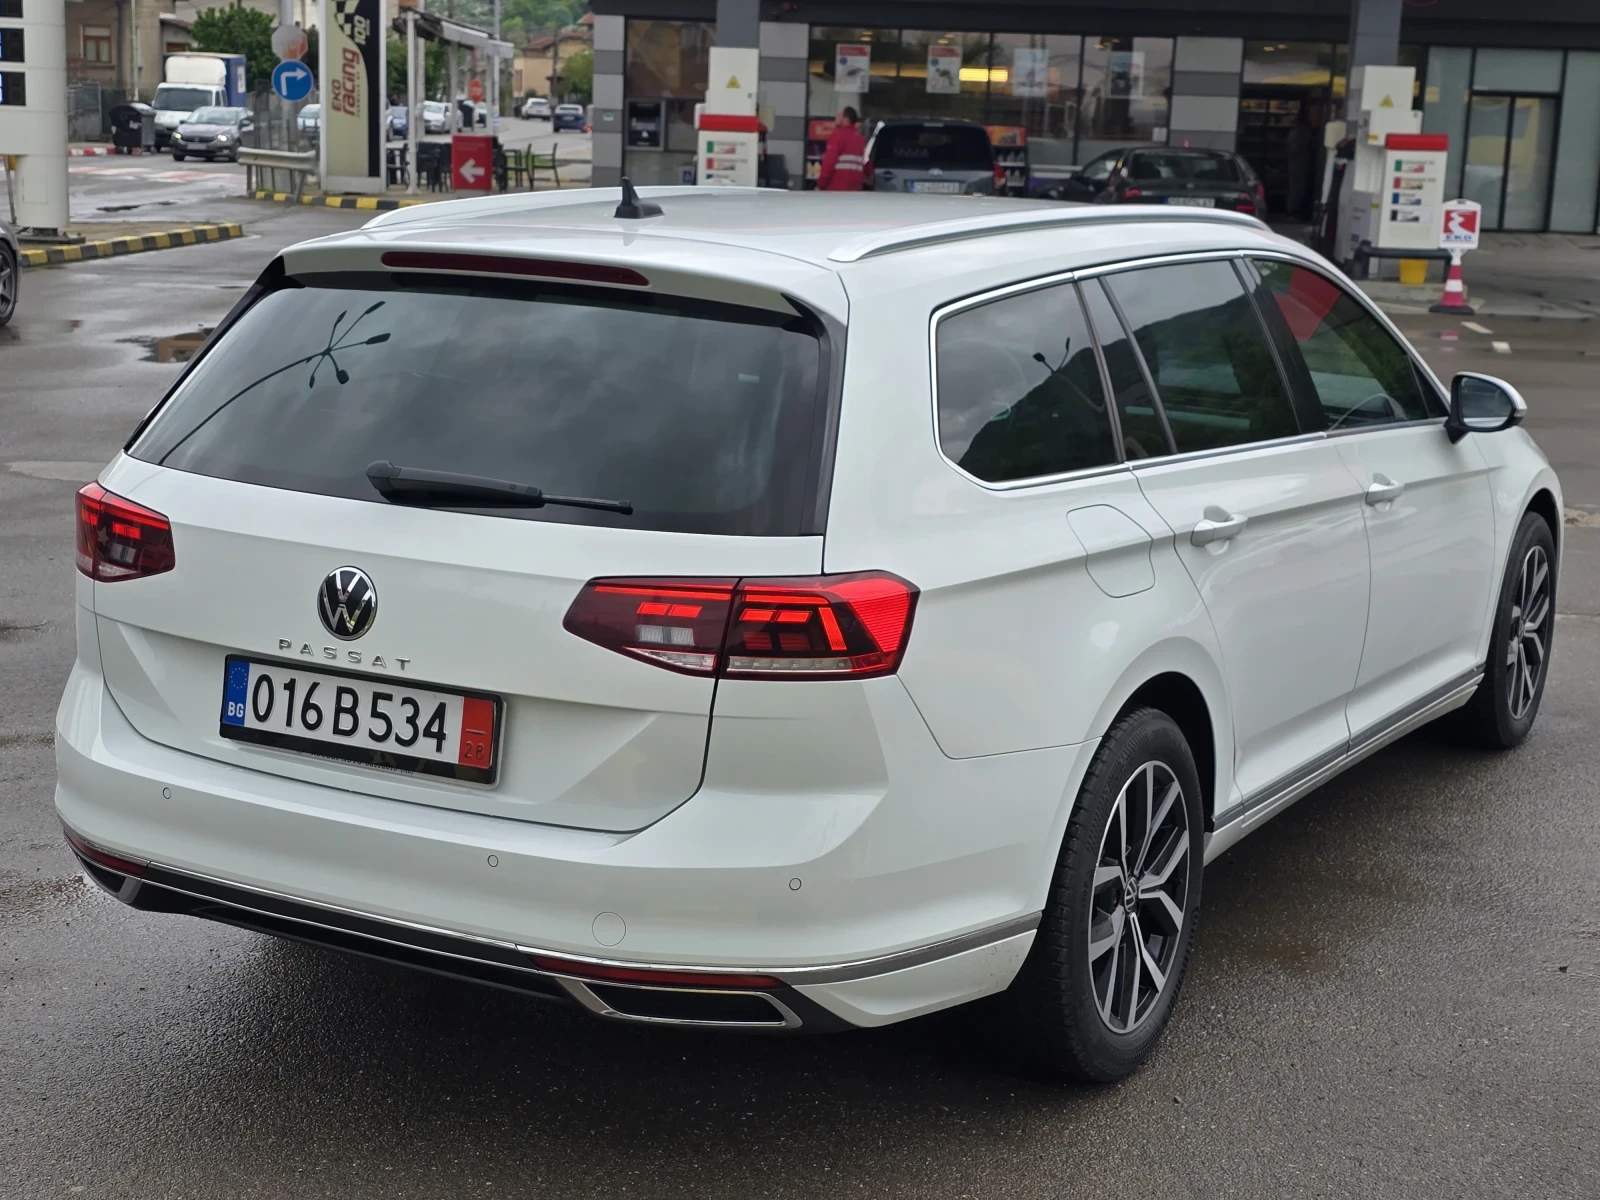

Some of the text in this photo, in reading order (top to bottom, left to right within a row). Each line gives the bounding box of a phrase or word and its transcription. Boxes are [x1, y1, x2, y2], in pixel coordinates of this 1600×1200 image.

[353, 14, 367, 45] 100
[331, 79, 342, 112] EKO
[342, 47, 360, 116] racing
[278, 637, 411, 671] PASSAT
[227, 701, 244, 718] BG
[464, 741, 485, 760] 28
